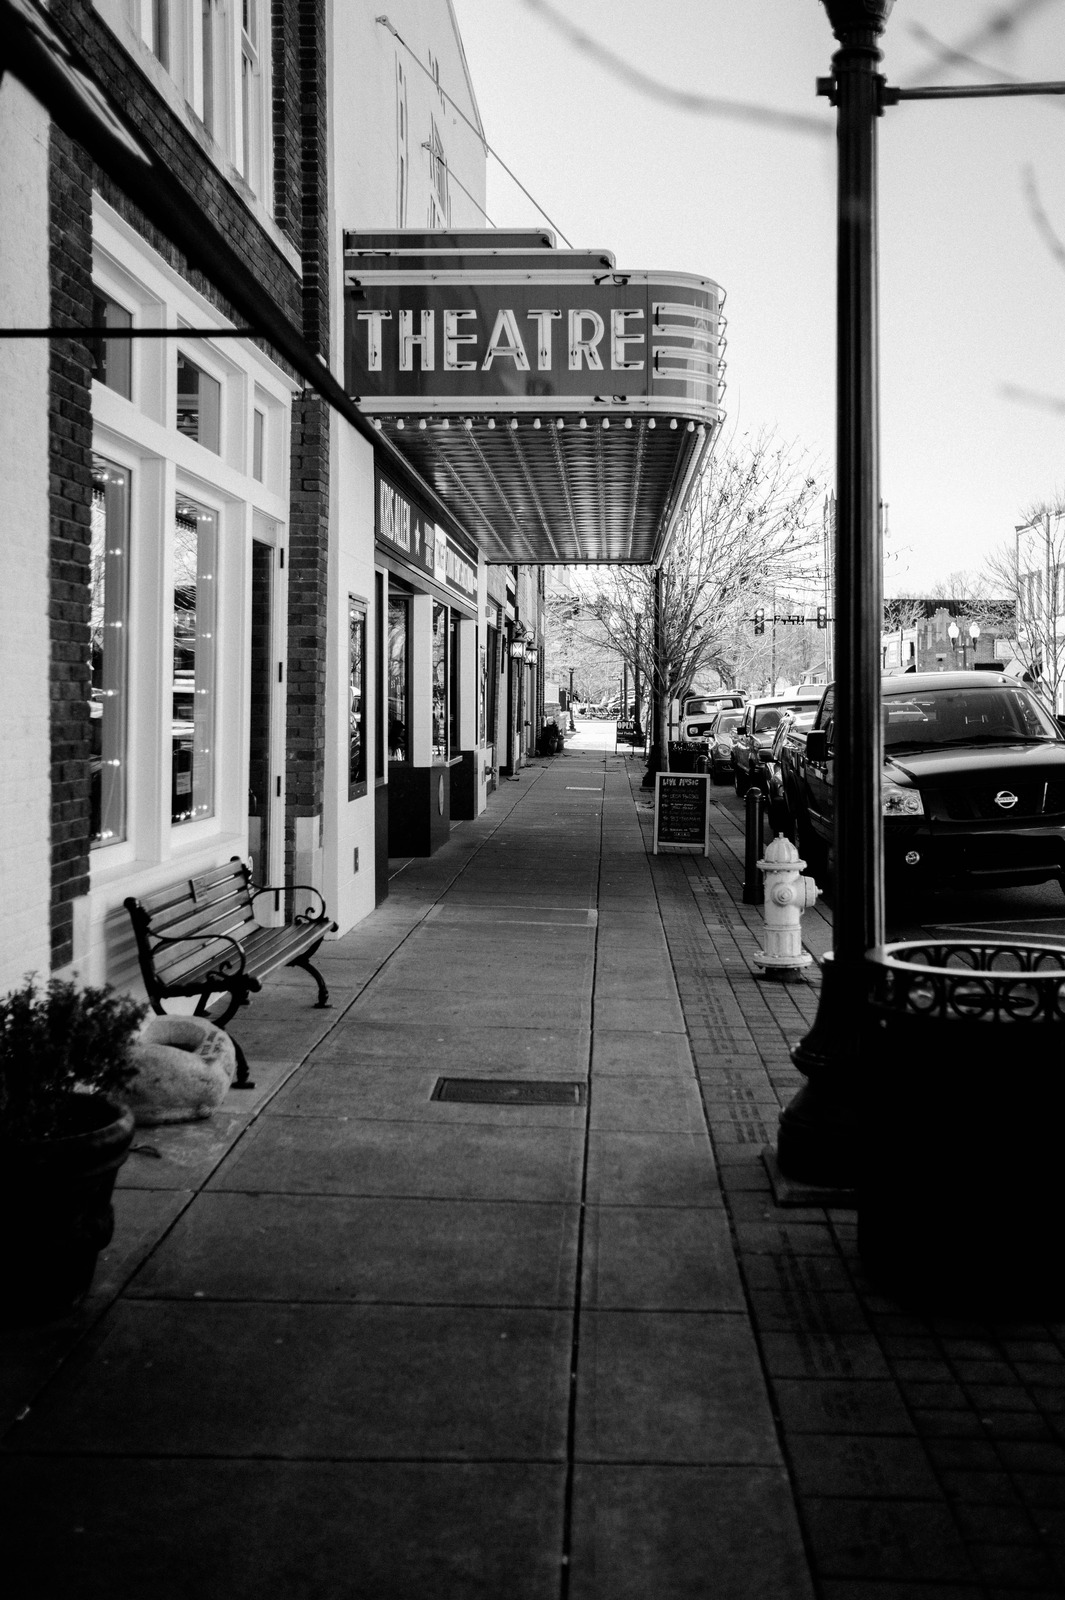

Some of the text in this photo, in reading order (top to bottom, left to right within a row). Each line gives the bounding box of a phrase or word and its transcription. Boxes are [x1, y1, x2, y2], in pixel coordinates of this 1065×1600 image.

[356, 309, 645, 371] THEATRE
[394, 492, 411, 553] ALLEN
[617, 721, 633, 729] OPEN
[662, 778, 699, 786] LIVE MUSIC
